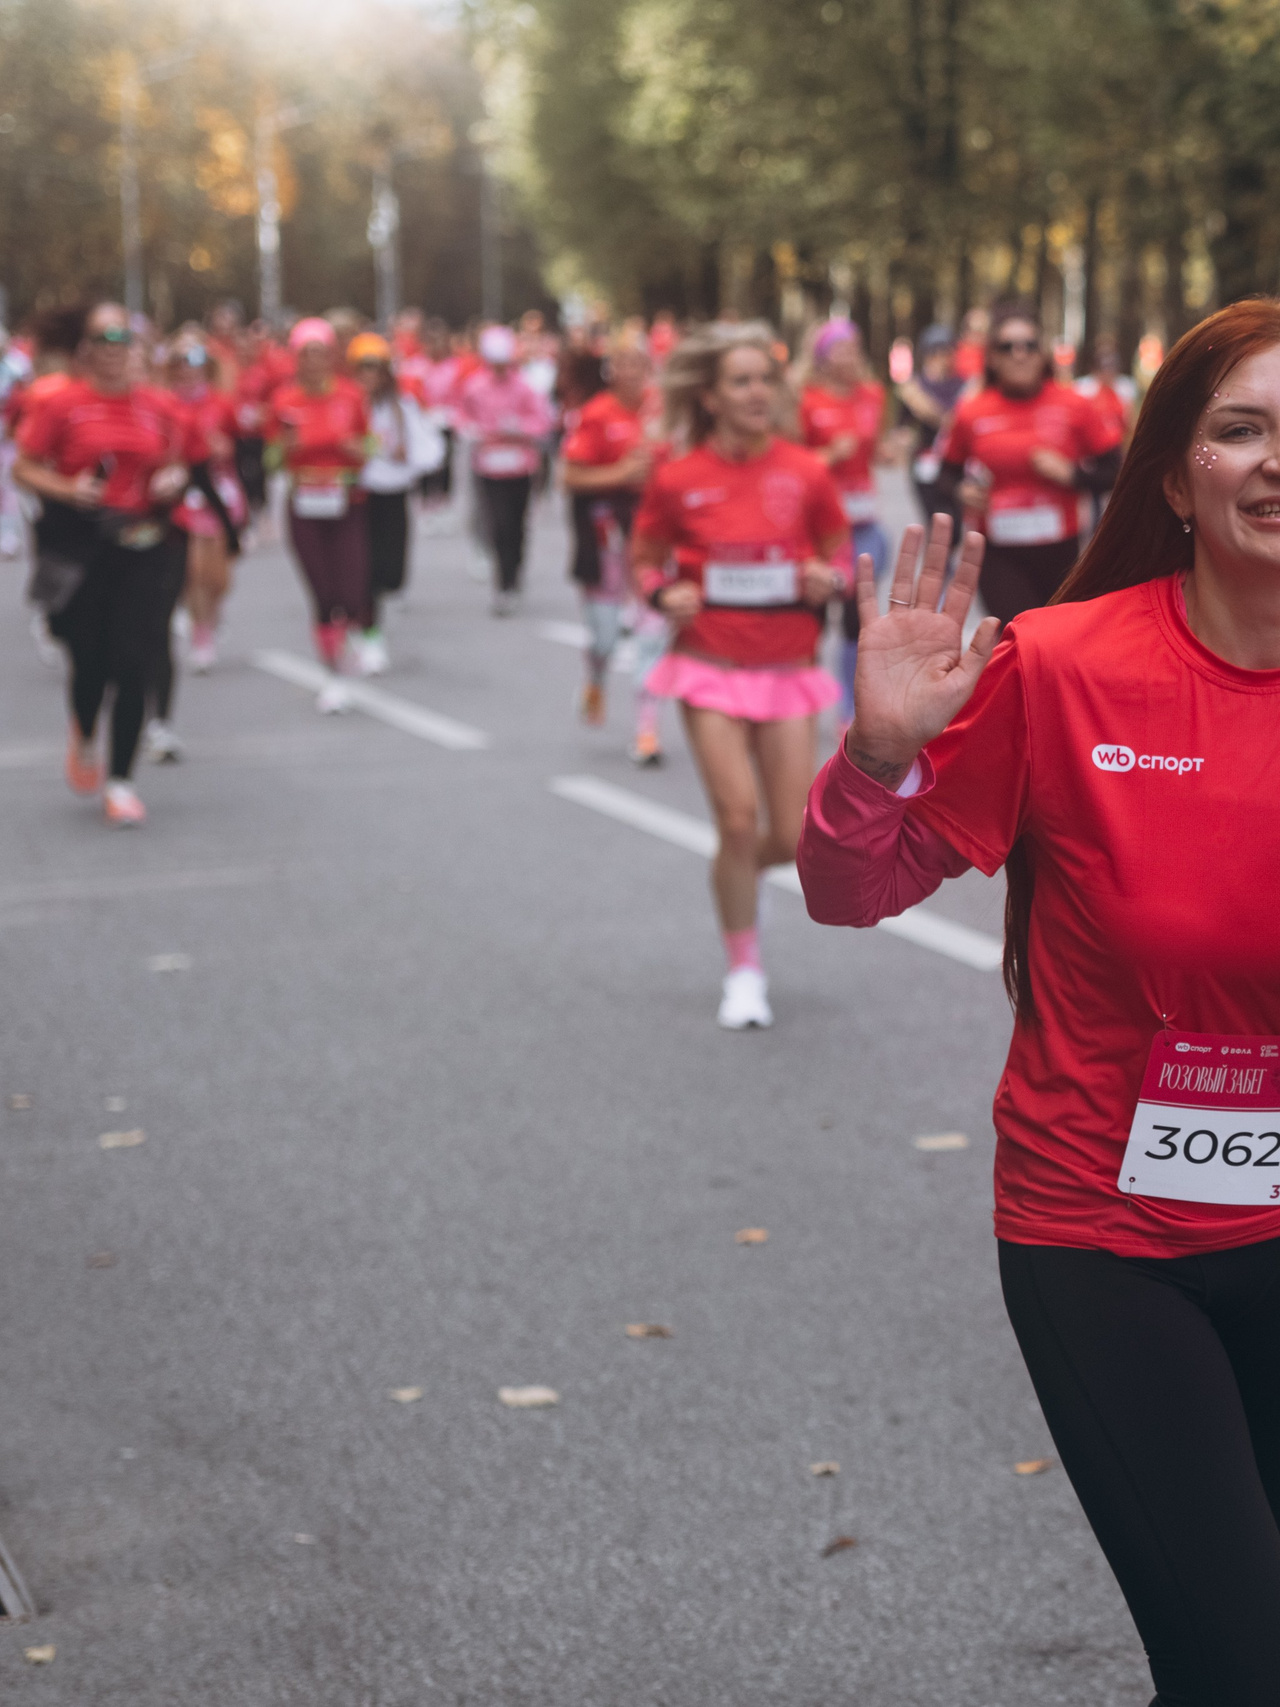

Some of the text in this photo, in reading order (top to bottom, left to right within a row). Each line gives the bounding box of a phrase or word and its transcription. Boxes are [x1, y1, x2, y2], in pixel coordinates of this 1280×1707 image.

[1158, 1062, 1268, 1094] РОЗОВЫЙ ЗАБЕГ
[1269, 1184, 1280, 1199] 3
